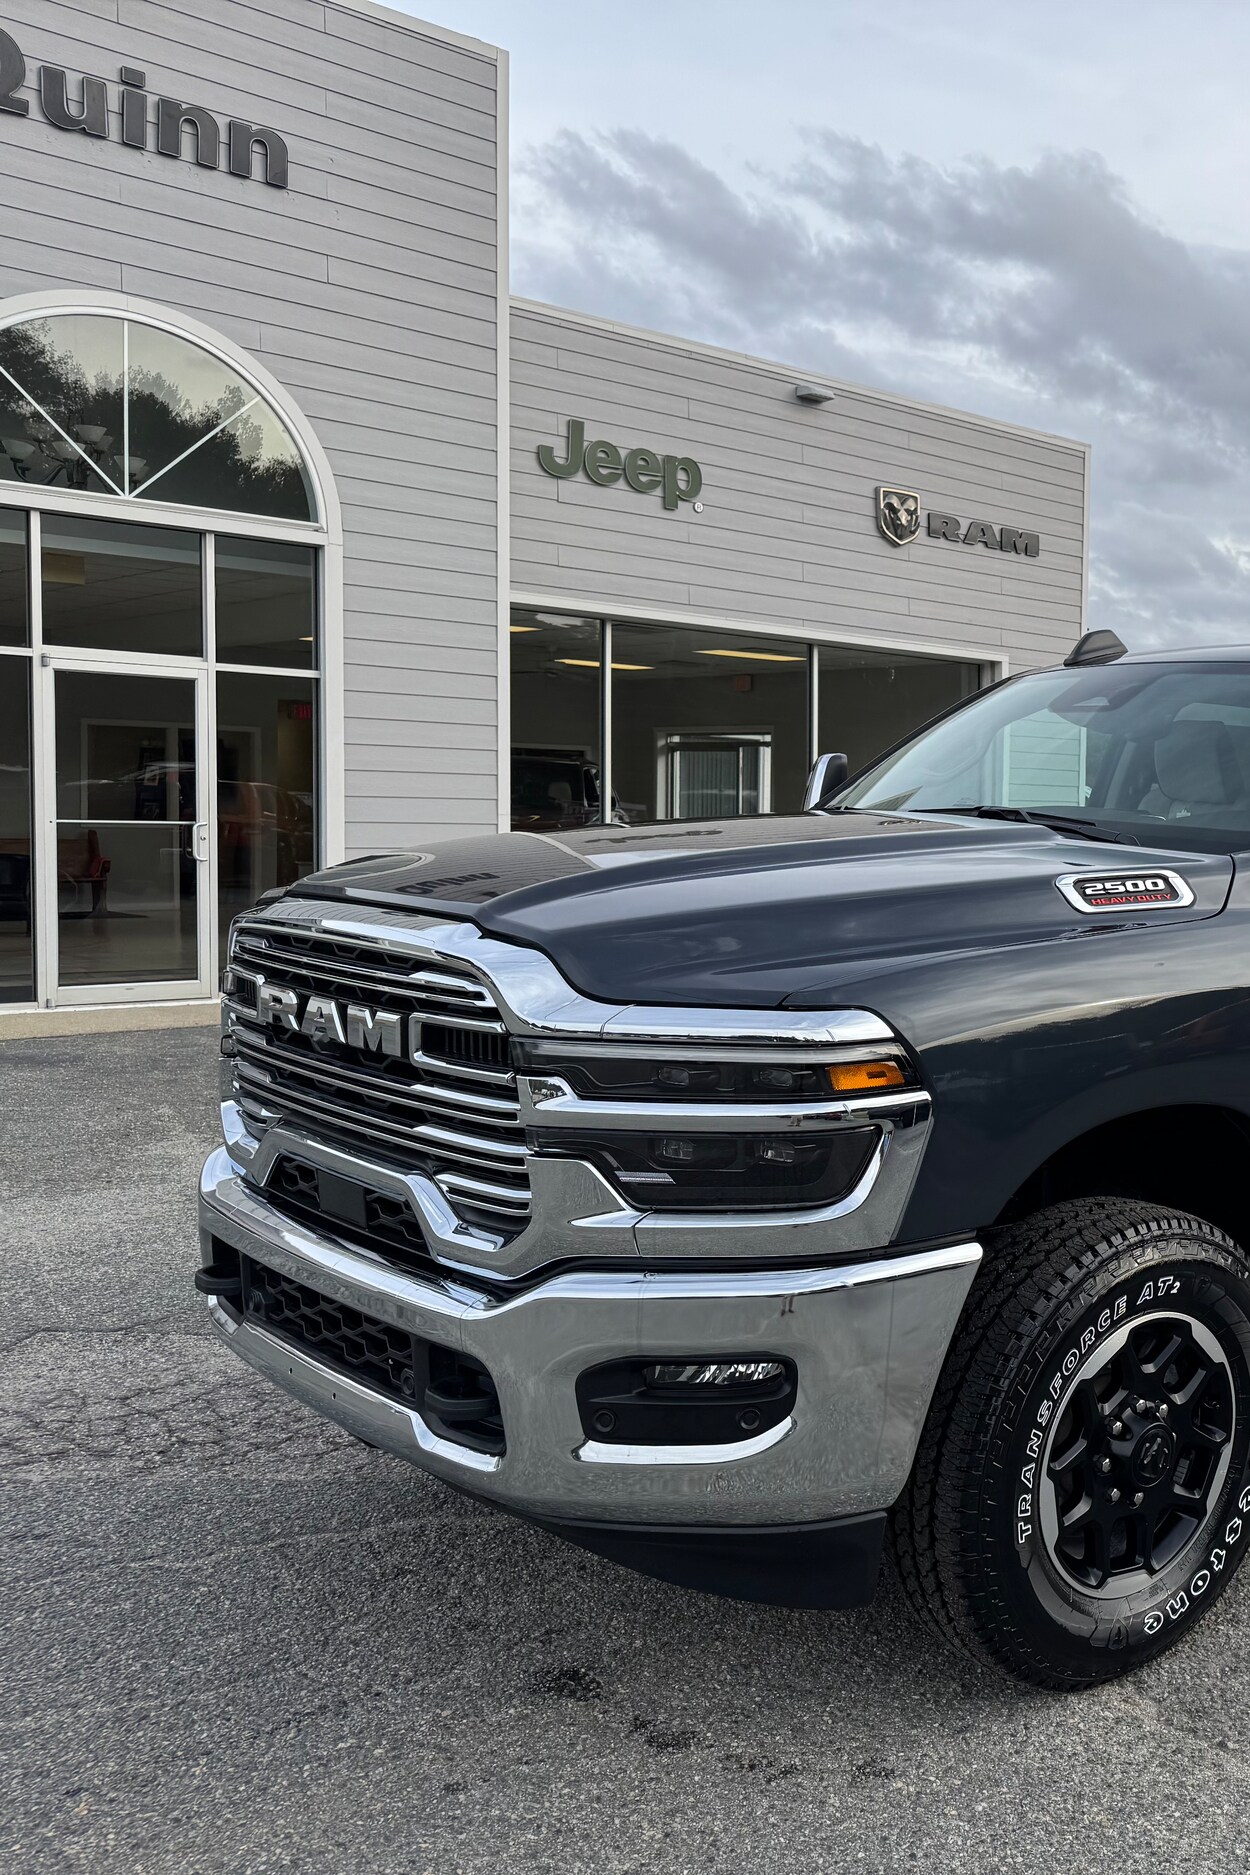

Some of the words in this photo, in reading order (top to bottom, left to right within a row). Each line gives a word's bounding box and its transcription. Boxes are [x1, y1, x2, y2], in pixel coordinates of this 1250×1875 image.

[537, 418, 703, 510] Jeep
[928, 511, 1040, 557] RAM
[1082, 878, 1166, 896] 2500
[1091, 896, 1135, 905] HEAVY
[1137, 893, 1171, 901] DUTY
[259, 985, 403, 1057] RAM
[1017, 1295, 1129, 1544] TRANSFORCE
[1136, 1276, 1181, 1306] AT2
